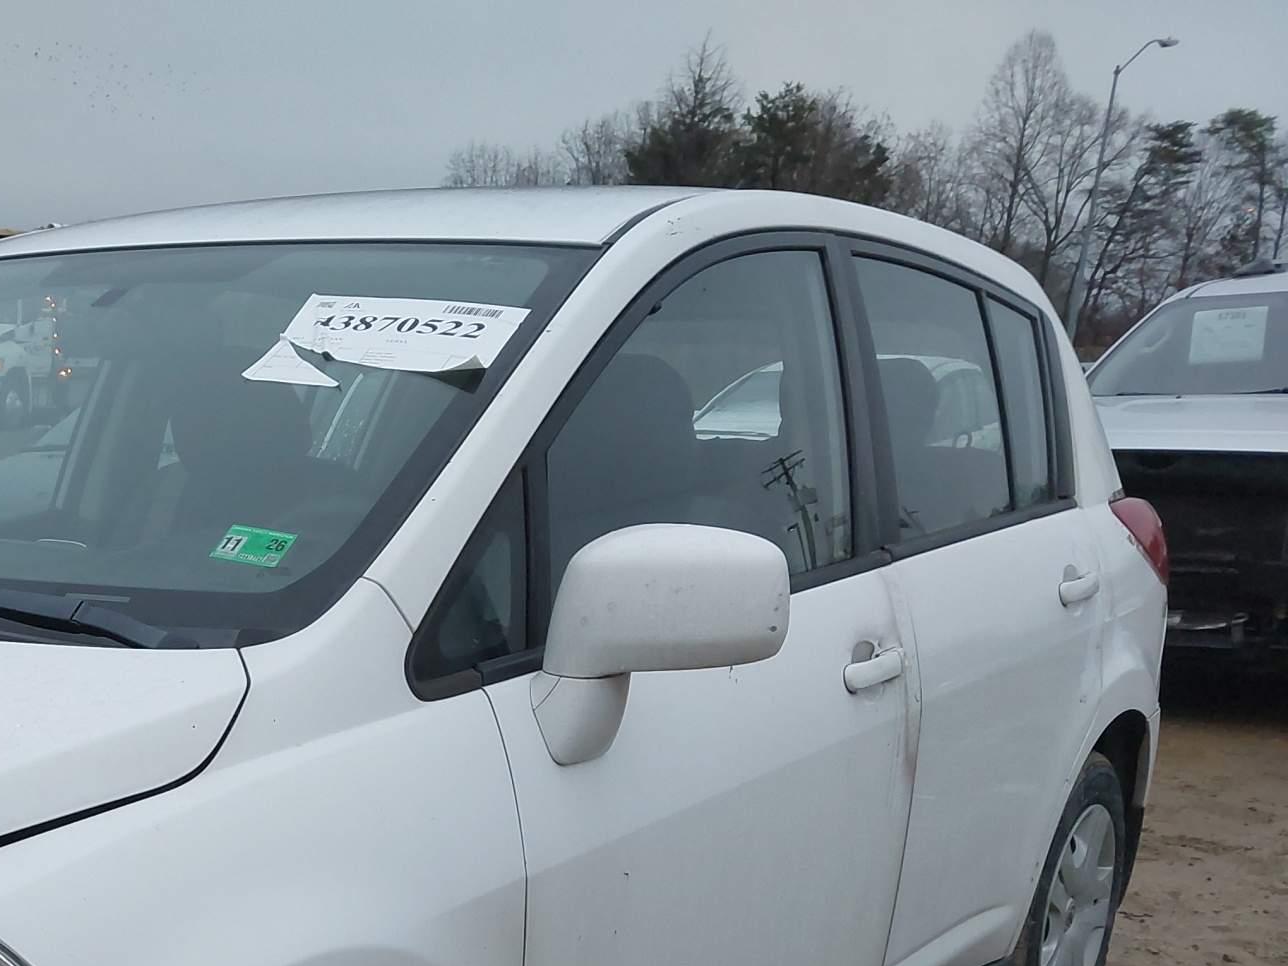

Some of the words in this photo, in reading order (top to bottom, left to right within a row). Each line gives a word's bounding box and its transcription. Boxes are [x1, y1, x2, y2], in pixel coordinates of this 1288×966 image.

[312, 315, 486, 339] 43870522
[221, 535, 243, 552] 11
[265, 538, 288, 553] 26
